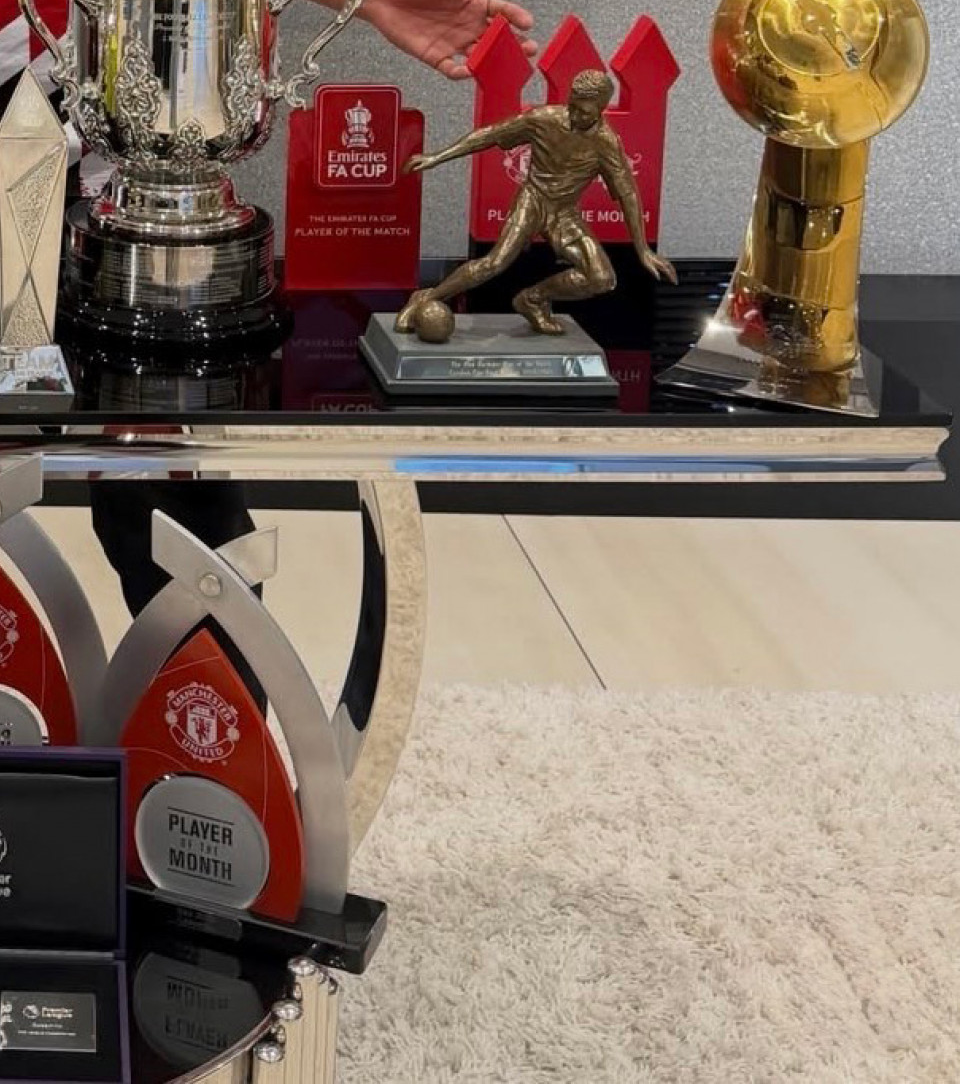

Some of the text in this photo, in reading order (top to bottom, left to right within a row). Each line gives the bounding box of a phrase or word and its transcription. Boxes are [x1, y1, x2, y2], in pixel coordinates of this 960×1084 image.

[327, 150, 388, 162] Emirates
[327, 164, 388, 178] FA CUP
[295, 228, 410, 236] PLAYER OF THE MATCH
[172, 688, 233, 721] MANCHESTER
[181, 738, 224, 756] UNITED
[169, 814, 232, 846] PLAYER
[169, 847, 232, 881] MONTH
